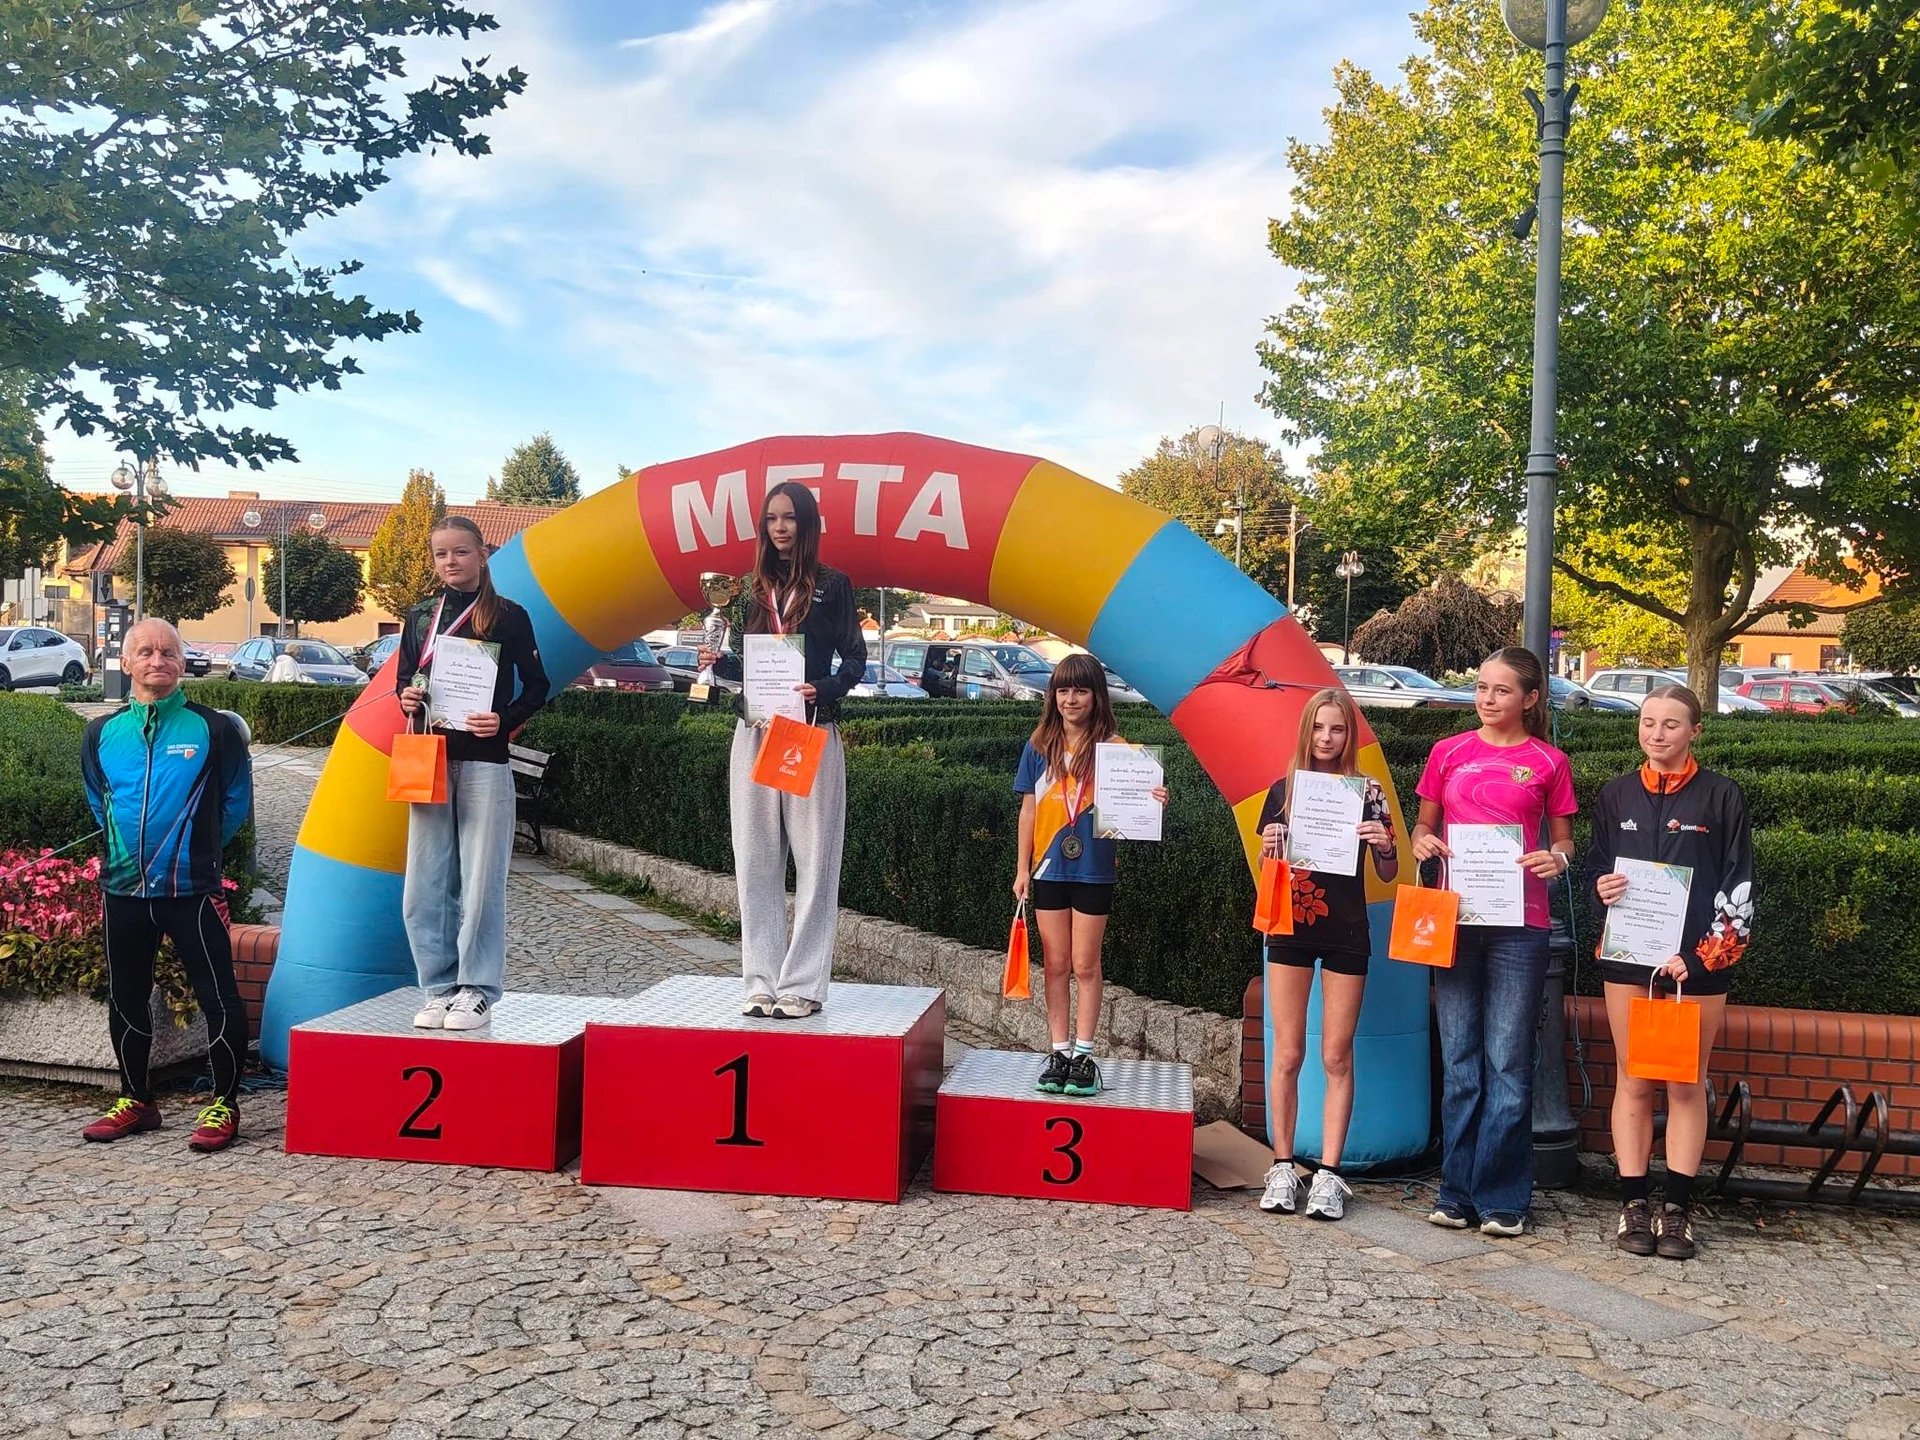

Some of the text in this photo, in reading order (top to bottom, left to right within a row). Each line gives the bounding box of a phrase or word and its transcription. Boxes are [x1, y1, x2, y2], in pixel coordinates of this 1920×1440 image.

[398, 1066, 443, 1140] 2
[713, 1053, 766, 1147] 1
[1041, 1117, 1085, 1185] 3
